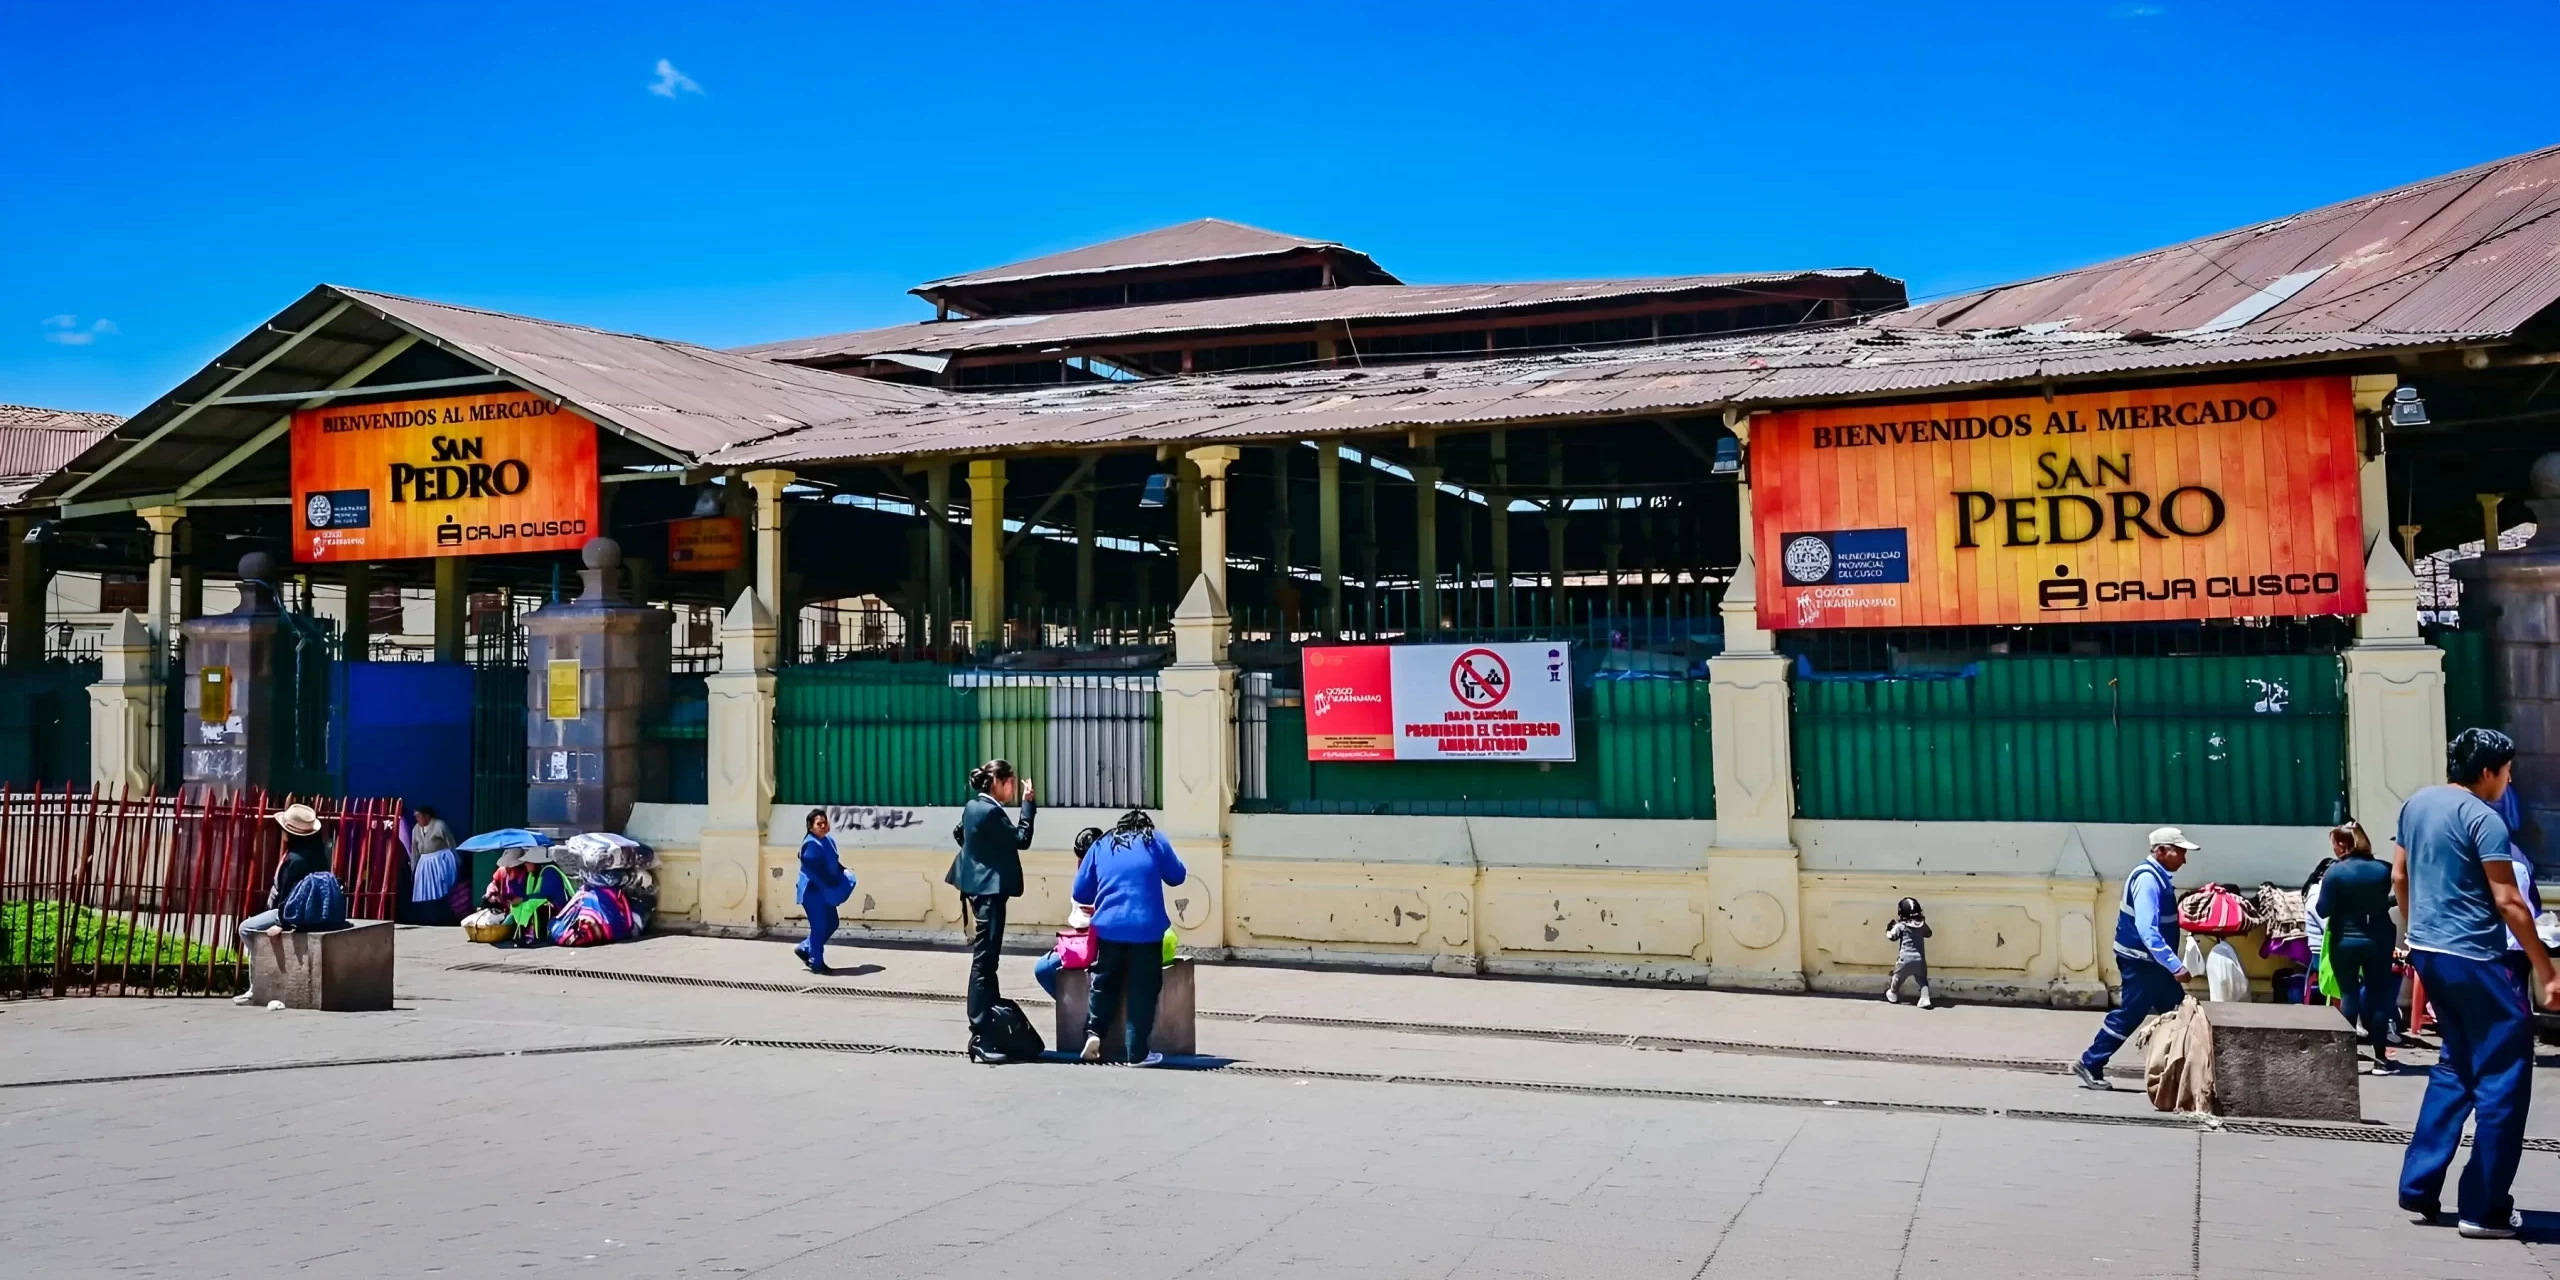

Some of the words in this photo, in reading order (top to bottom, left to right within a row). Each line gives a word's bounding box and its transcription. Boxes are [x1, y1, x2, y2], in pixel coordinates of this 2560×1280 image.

[323, 408, 436, 433] BIENVENIDOS
[442, 406, 464, 424] AL
[469, 399, 560, 421] MERCADO
[1813, 414, 2032, 449] BIENVENIDOS
[2043, 410, 2087, 434] AL
[2096, 396, 2277, 432] MERCADO
[431, 435, 483, 462] SAN
[389, 459, 530, 503] PEDRO
[2037, 452, 2132, 490] SAN
[466, 524, 517, 541] CAJA
[521, 519, 586, 538] CUSCO
[1950, 485, 2226, 549] PEDRO
[2096, 579, 2197, 602] CAJA
[2206, 572, 2339, 598] CUSCO
[1405, 724, 1474, 737] PROHIBIDO
[1477, 724, 1490, 736] EL
[1492, 723, 1561, 737] COMERCIO
[1438, 738, 1528, 751] AMBULATORIO
